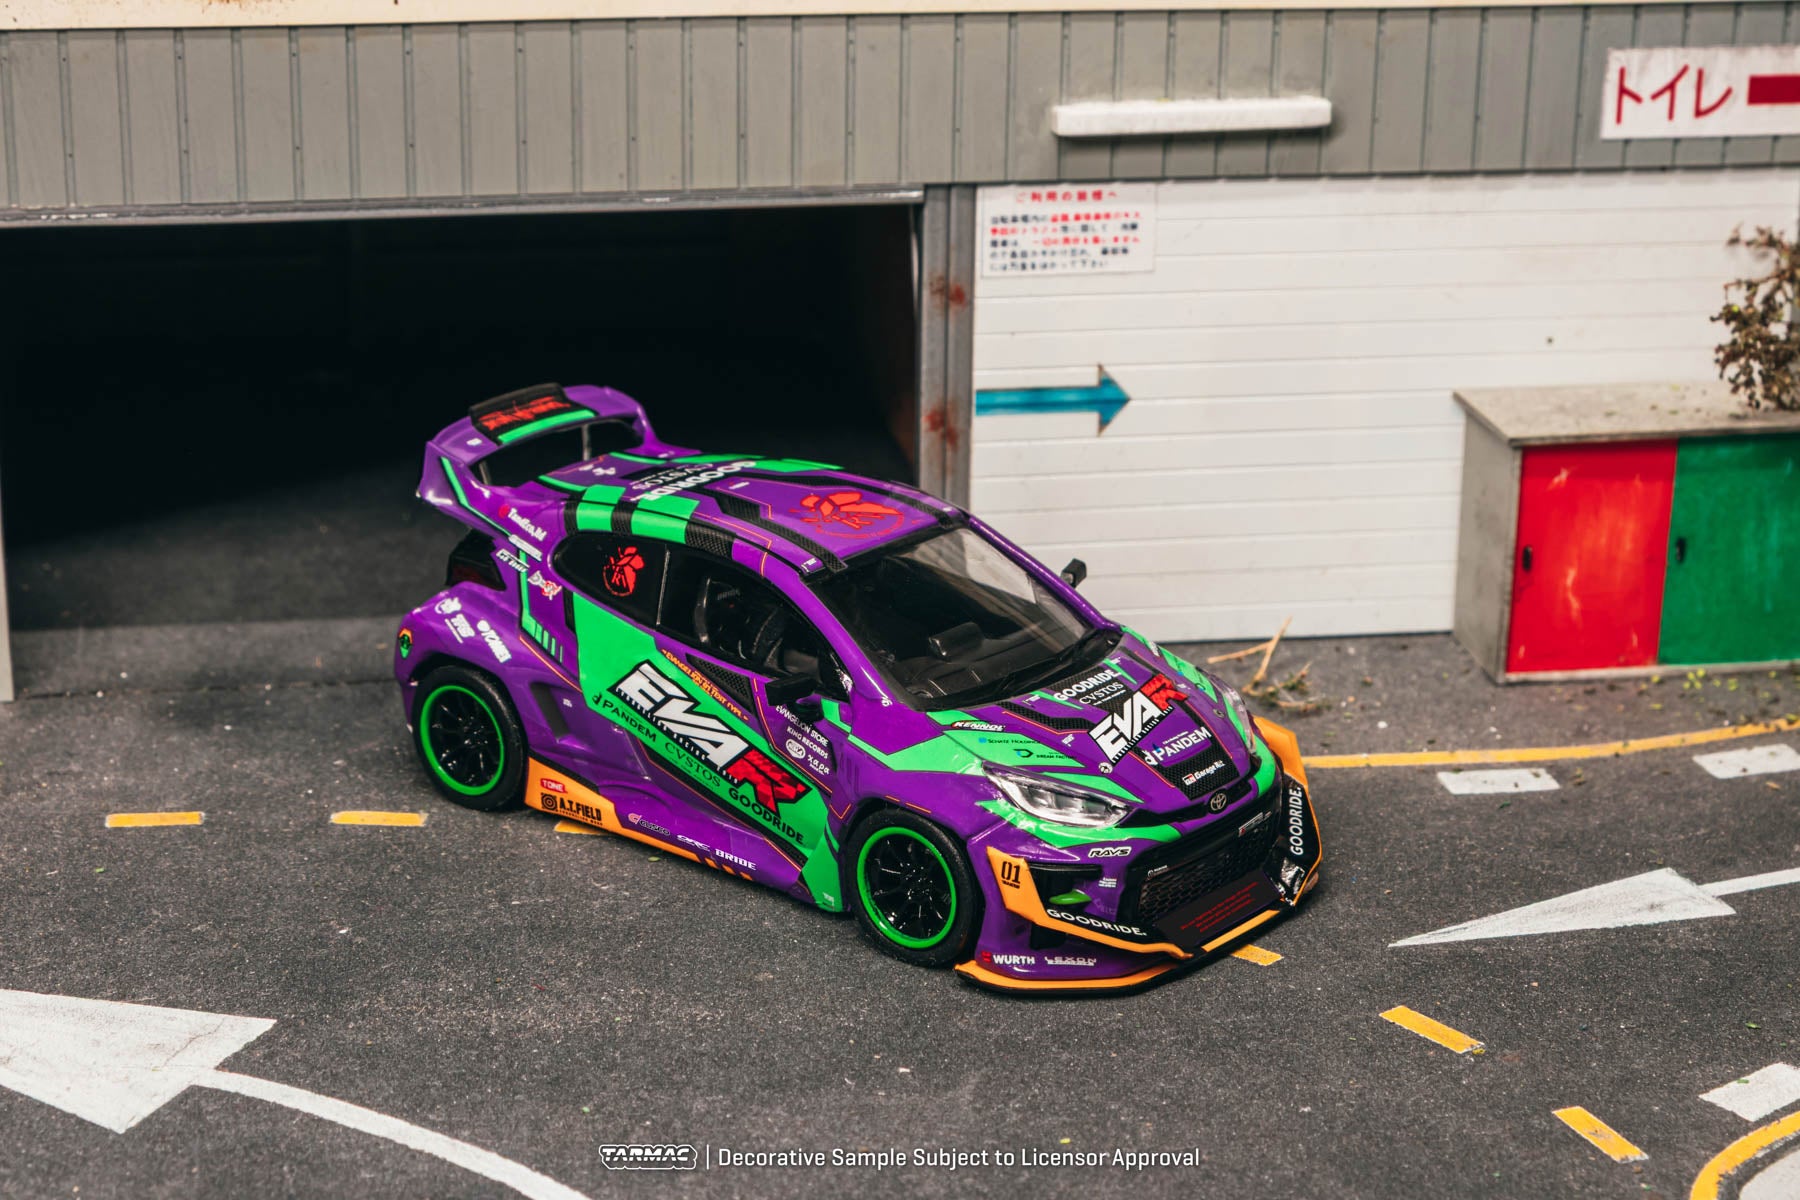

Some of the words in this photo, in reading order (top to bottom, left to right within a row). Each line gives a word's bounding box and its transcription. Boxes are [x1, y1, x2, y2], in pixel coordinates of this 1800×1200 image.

[1615, 64, 1733, 125] トイレ
[1079, 681, 1124, 705] CVSTOS
[776, 704, 811, 734] EVANGELION
[810, 729, 829, 747] STORE
[786, 726, 802, 740] KING
[802, 736, 829, 759] RECORDS
[1152, 726, 1212, 761] PANDEM
[602, 698, 658, 743] PANDEM
[664, 741, 722, 788] CVSTOS
[728, 787, 805, 846] GOODRIDE
[715, 848, 757, 871] BRIDE
[1090, 847, 1131, 857] RAYS
[1001, 861, 1021, 884] 01
